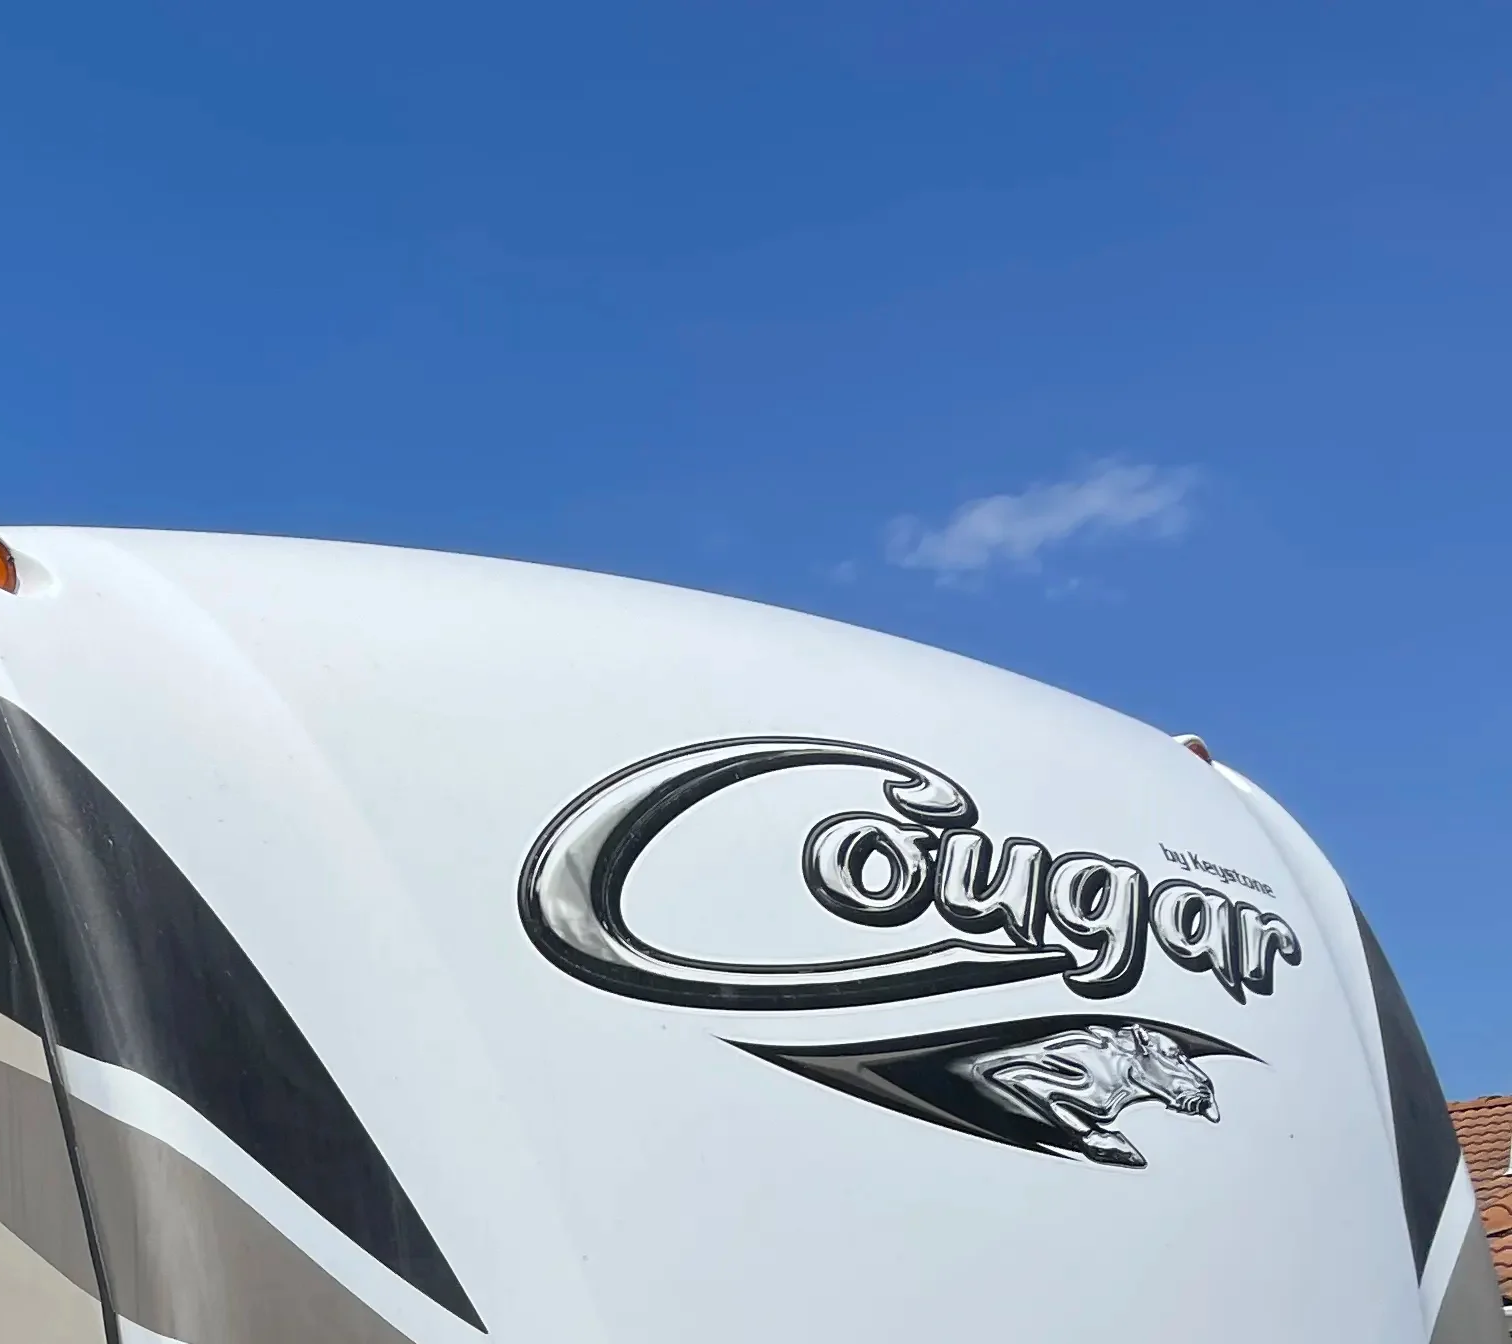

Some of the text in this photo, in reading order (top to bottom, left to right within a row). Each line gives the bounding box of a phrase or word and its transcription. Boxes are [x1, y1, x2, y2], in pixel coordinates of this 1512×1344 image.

[517, 736, 1301, 1010] Cougar
[1159, 842, 1276, 898] by Keystone
